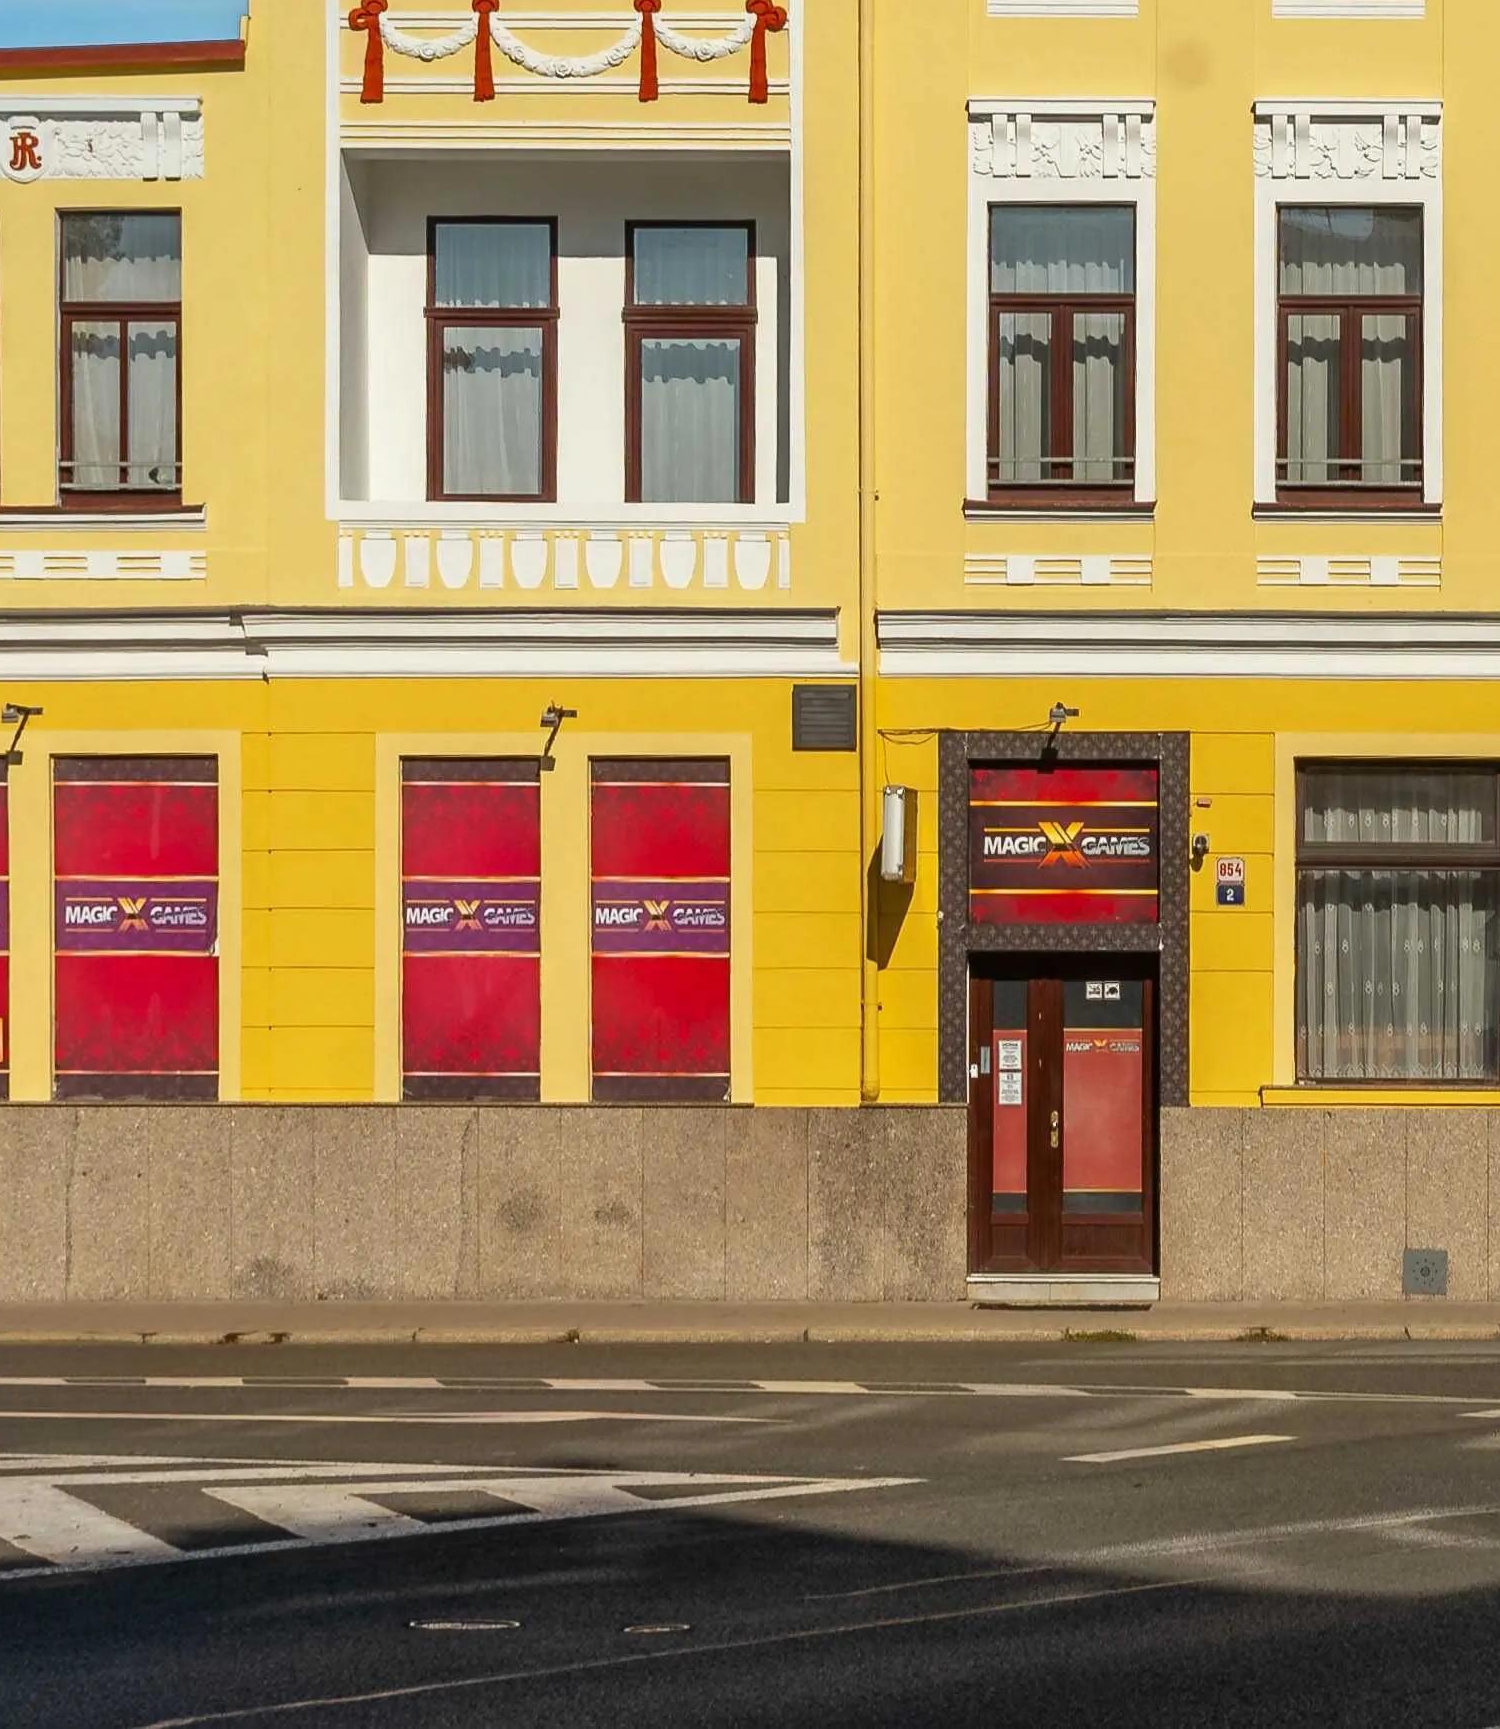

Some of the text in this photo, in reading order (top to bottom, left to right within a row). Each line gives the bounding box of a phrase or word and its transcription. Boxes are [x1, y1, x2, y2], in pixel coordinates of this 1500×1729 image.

[984, 836, 1046, 855] MAGIC
[1081, 836, 1150, 855] GAMES
[1220, 862, 1242, 877] 854
[1226, 888, 1235, 901] 2
[65, 905, 118, 925] MAGIC
[150, 906, 207, 925] GAMES
[406, 907, 453, 925] MAGIC
[483, 908, 535, 925] GAMES
[595, 907, 643, 925] MAGIC
[673, 908, 725, 925] GAMES
